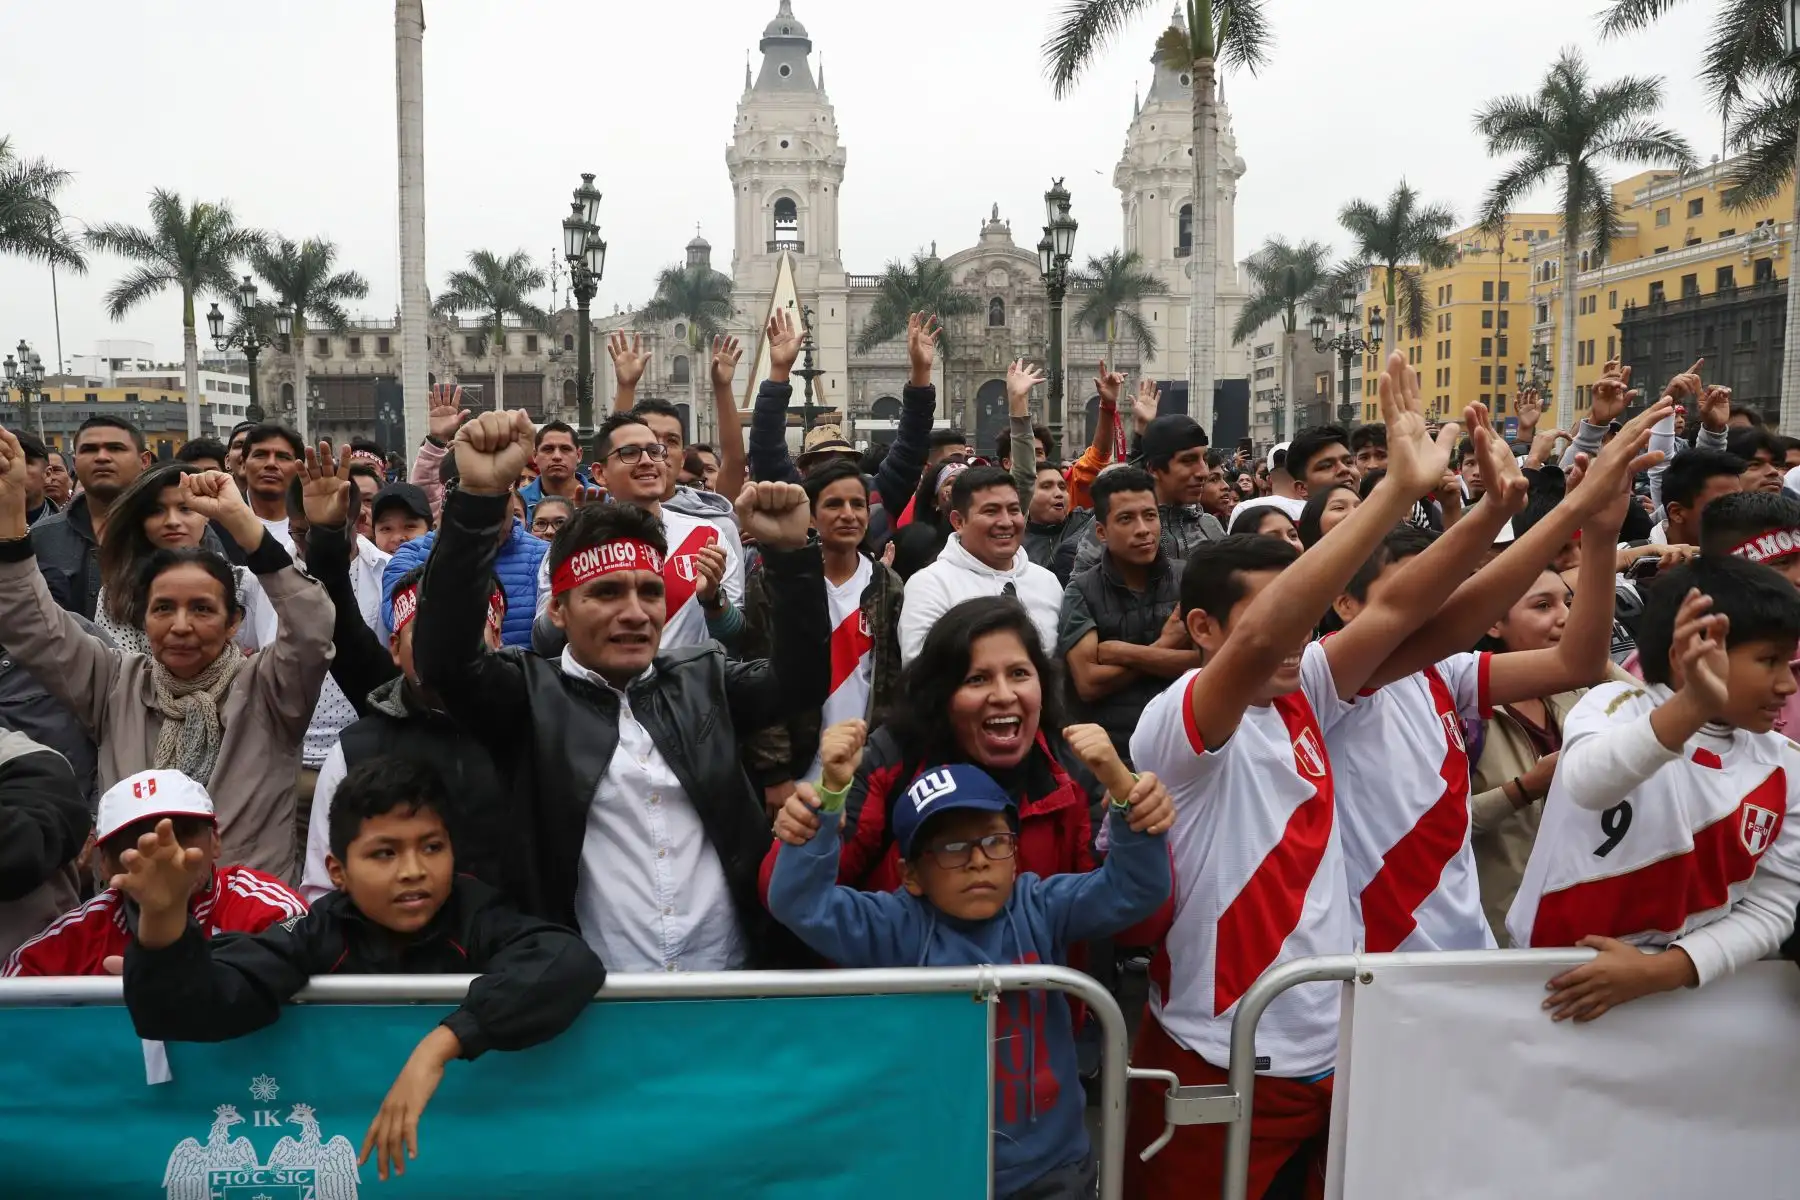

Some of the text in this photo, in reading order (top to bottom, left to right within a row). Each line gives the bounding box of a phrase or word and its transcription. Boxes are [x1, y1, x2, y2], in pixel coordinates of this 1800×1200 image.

[571, 542, 636, 576] CONTIGO
[1593, 799, 1633, 858] 9
[253, 1110, 282, 1127] IK
[212, 1171, 267, 1185] HOC
